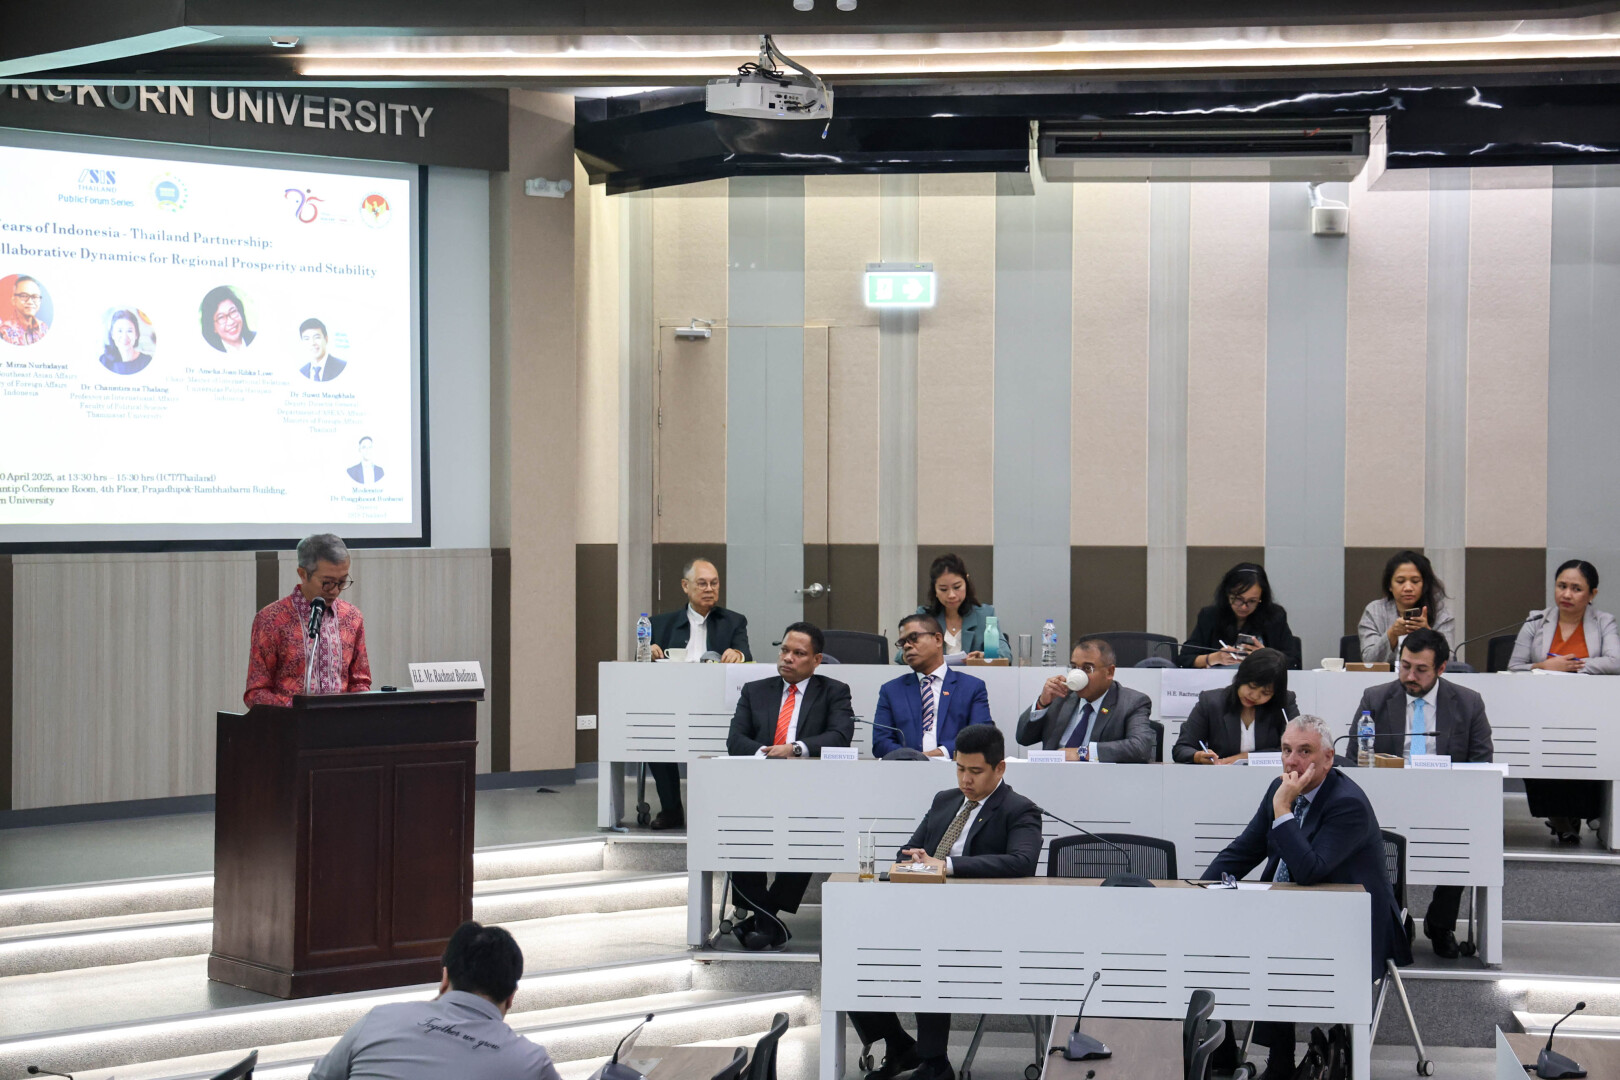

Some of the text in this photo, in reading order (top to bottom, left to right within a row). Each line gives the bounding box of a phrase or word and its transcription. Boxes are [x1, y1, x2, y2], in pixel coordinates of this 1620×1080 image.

[210, 86, 433, 137] UNIVERSITY
[78, 184, 117, 193] THAILAND
[58, 193, 135, 207] Public Forum Series
[0, 218, 32, 233] ears
[35, 222, 50, 233] of
[52, 222, 120, 238] Indonesia
[130, 228, 189, 243] Thailand
[193, 232, 273, 250] Partnership:
[0, 242, 377, 278] llaborative Dynamics for Regional Prosperity and Stability
[15, 380, 43, 388] Foreign
[4, 388, 39, 397] Indonesia
[6, 472, 30, 482] April
[31, 472, 54, 482] 2025,
[93, 473, 107, 481] hrs
[140, 473, 154, 481] hrs
[21, 484, 70, 493] Conference
[71, 484, 99, 494] Room,
[100, 485, 115, 493] 4th
[116, 485, 140, 494] Floor,
[252, 485, 288, 495] Building,
[8, 495, 55, 506] University
[412, 669, 478, 683] H.E. Mr. Rachmat Budiman
[417, 1016, 500, 1050] Together we grow
